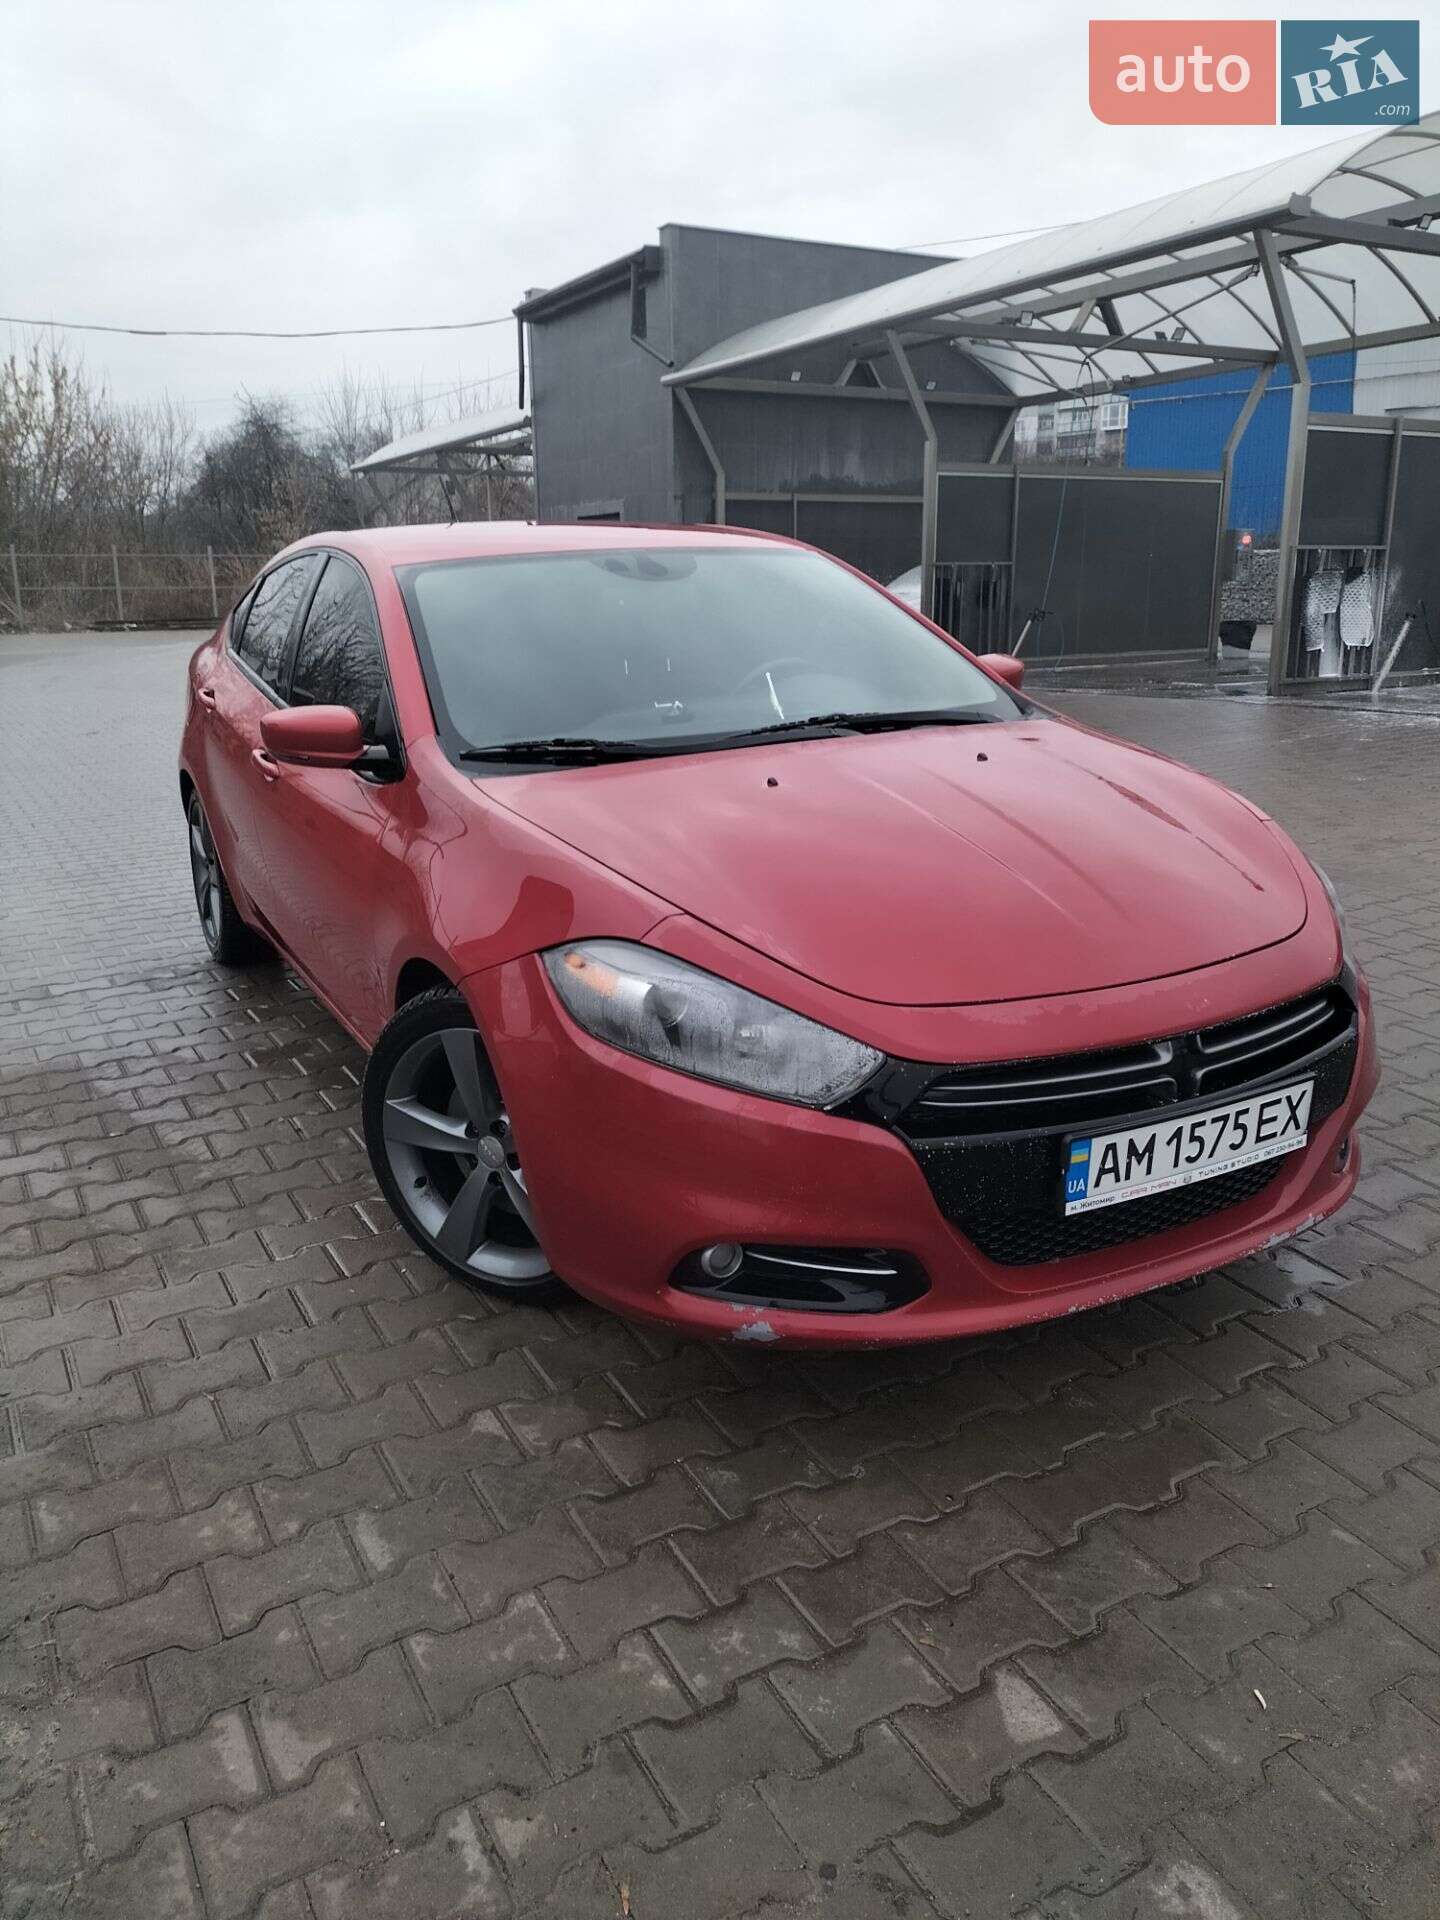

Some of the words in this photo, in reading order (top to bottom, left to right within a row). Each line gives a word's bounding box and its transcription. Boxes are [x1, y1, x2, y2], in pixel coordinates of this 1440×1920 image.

[1093, 1132, 1156, 1190] AM
[1166, 1107, 1250, 1168] 1575
[1255, 1090, 1307, 1144] EX
[1068, 1178, 1085, 1193] UA
[1080, 1196, 1116, 1208] Житомир
